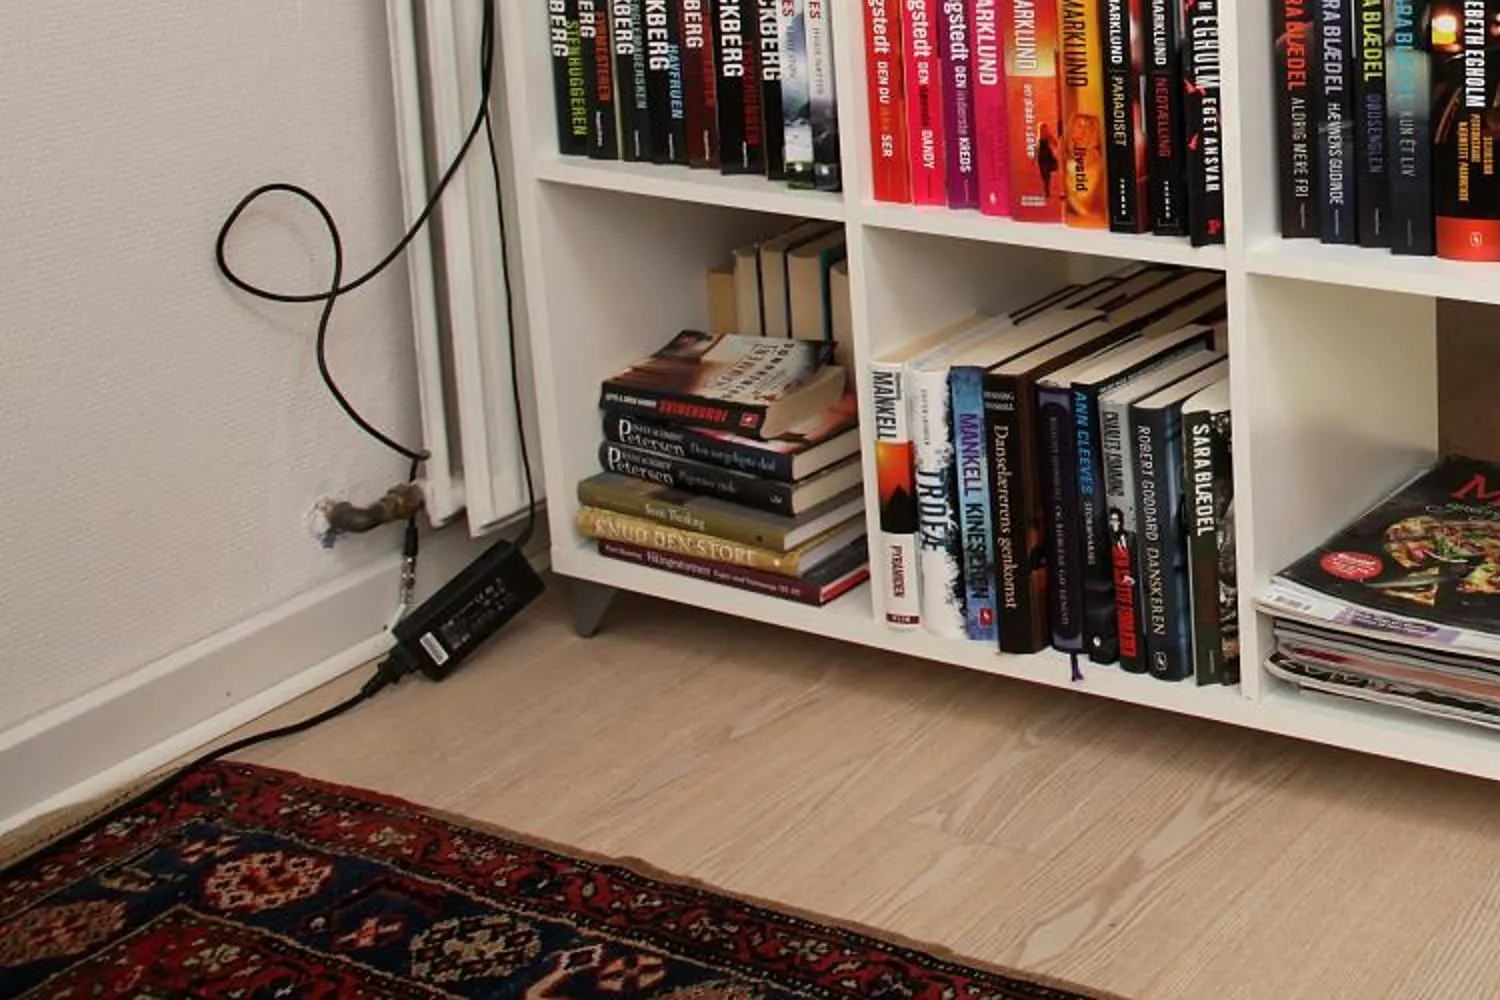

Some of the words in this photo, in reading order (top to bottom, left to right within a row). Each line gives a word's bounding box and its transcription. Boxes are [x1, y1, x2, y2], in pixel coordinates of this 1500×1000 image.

[878, 61, 889, 84] DEN
[919, 61, 930, 85] DEN
[1192, 15, 1220, 90] EGHOLM
[1286, 21, 1307, 90] BLÆDEL
[1323, 26, 1342, 95] BLÆDEL
[1362, 12, 1383, 81] BLÆDEL
[565, 20, 588, 136] STENHUGGEREN
[667, 44, 683, 120] HAVFRUEN
[879, 86, 890, 105] DU
[955, 65, 967, 88] DEN
[1465, 50, 1485, 107] EGHOLM
[1112, 76, 1127, 147] PARADISET
[1202, 97, 1216, 132] EGET
[881, 134, 893, 158] SER
[922, 129, 935, 169] DANDY
[959, 137, 971, 173] KREDS
[1205, 137, 1220, 192] ANSVAR
[1295, 178, 1309, 197] FRI
[871, 371, 898, 440] MANKELL
[1075, 392, 1090, 426] ANN
[607, 447, 673, 485] Petersen
[618, 419, 687, 457] Petersen
[959, 413, 981, 496] MANKELL
[1075, 431, 1093, 496] CLEEVES
[1137, 425, 1154, 477] ROBERT
[1192, 424, 1212, 470] SARA
[993, 424, 1014, 535] Danselærerens
[1194, 472, 1215, 537] BLÆDEL
[594, 517, 647, 547] KNUD
[654, 529, 695, 553] DEN
[917, 468, 948, 552] TROFÆ
[1142, 480, 1157, 542] GODDARD
[891, 545, 905, 598] PYRAMIDEN
[965, 502, 990, 599] KINESEREN
[998, 537, 1018, 609] genkomst
[1146, 547, 1165, 635] DANSKEREN
